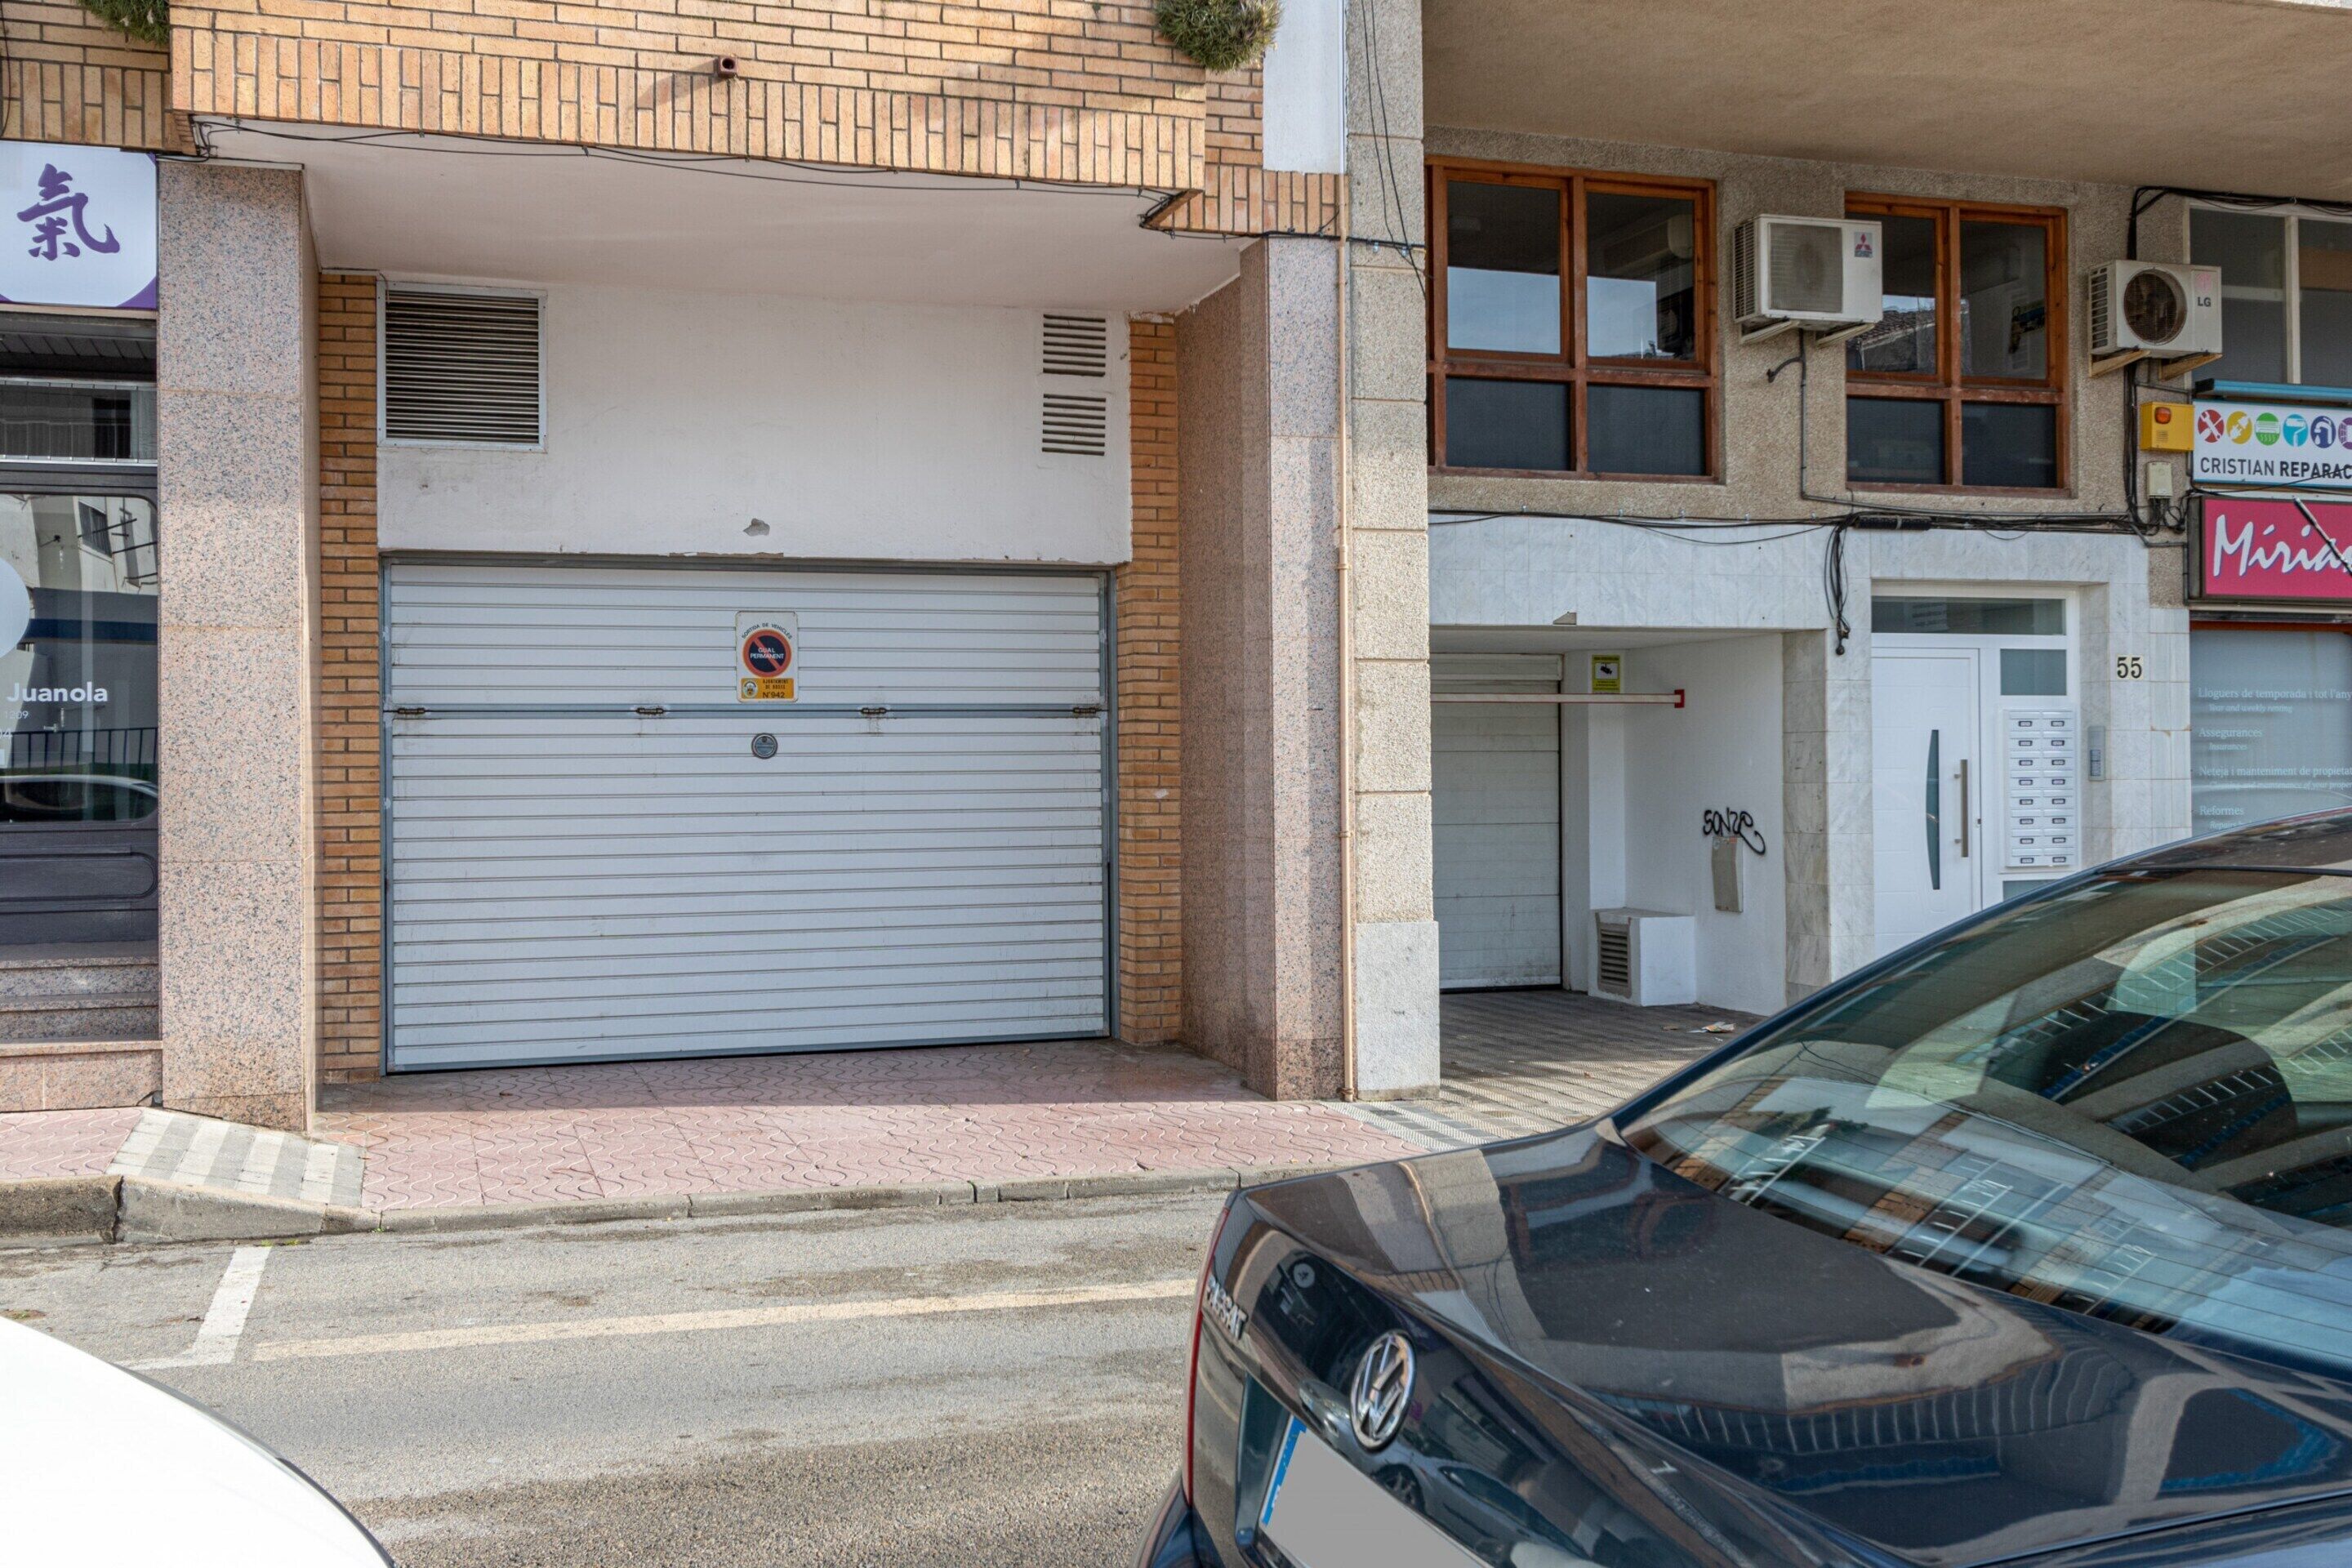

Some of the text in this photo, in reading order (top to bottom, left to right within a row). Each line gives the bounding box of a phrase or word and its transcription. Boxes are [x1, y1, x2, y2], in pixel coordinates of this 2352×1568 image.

[16, 163, 120, 261] 氣
[2197, 296, 2212, 307] LG
[2200, 457, 2274, 476] CRISTIAN
[2117, 657, 2142, 679] 55
[7, 681, 108, 702] Juanola
[2198, 688, 2239, 700] Lloguers
[2242, 688, 2252, 698] de
[2256, 689, 2307, 700] temporada
[2314, 689, 2328, 698] tot
[2199, 728, 2262, 738] Assegurances
[2199, 767, 2229, 777] Neteja
[2237, 767, 2297, 776] manteniment
[2299, 766, 2309, 776] de
[2200, 805, 2244, 815] Reformes
